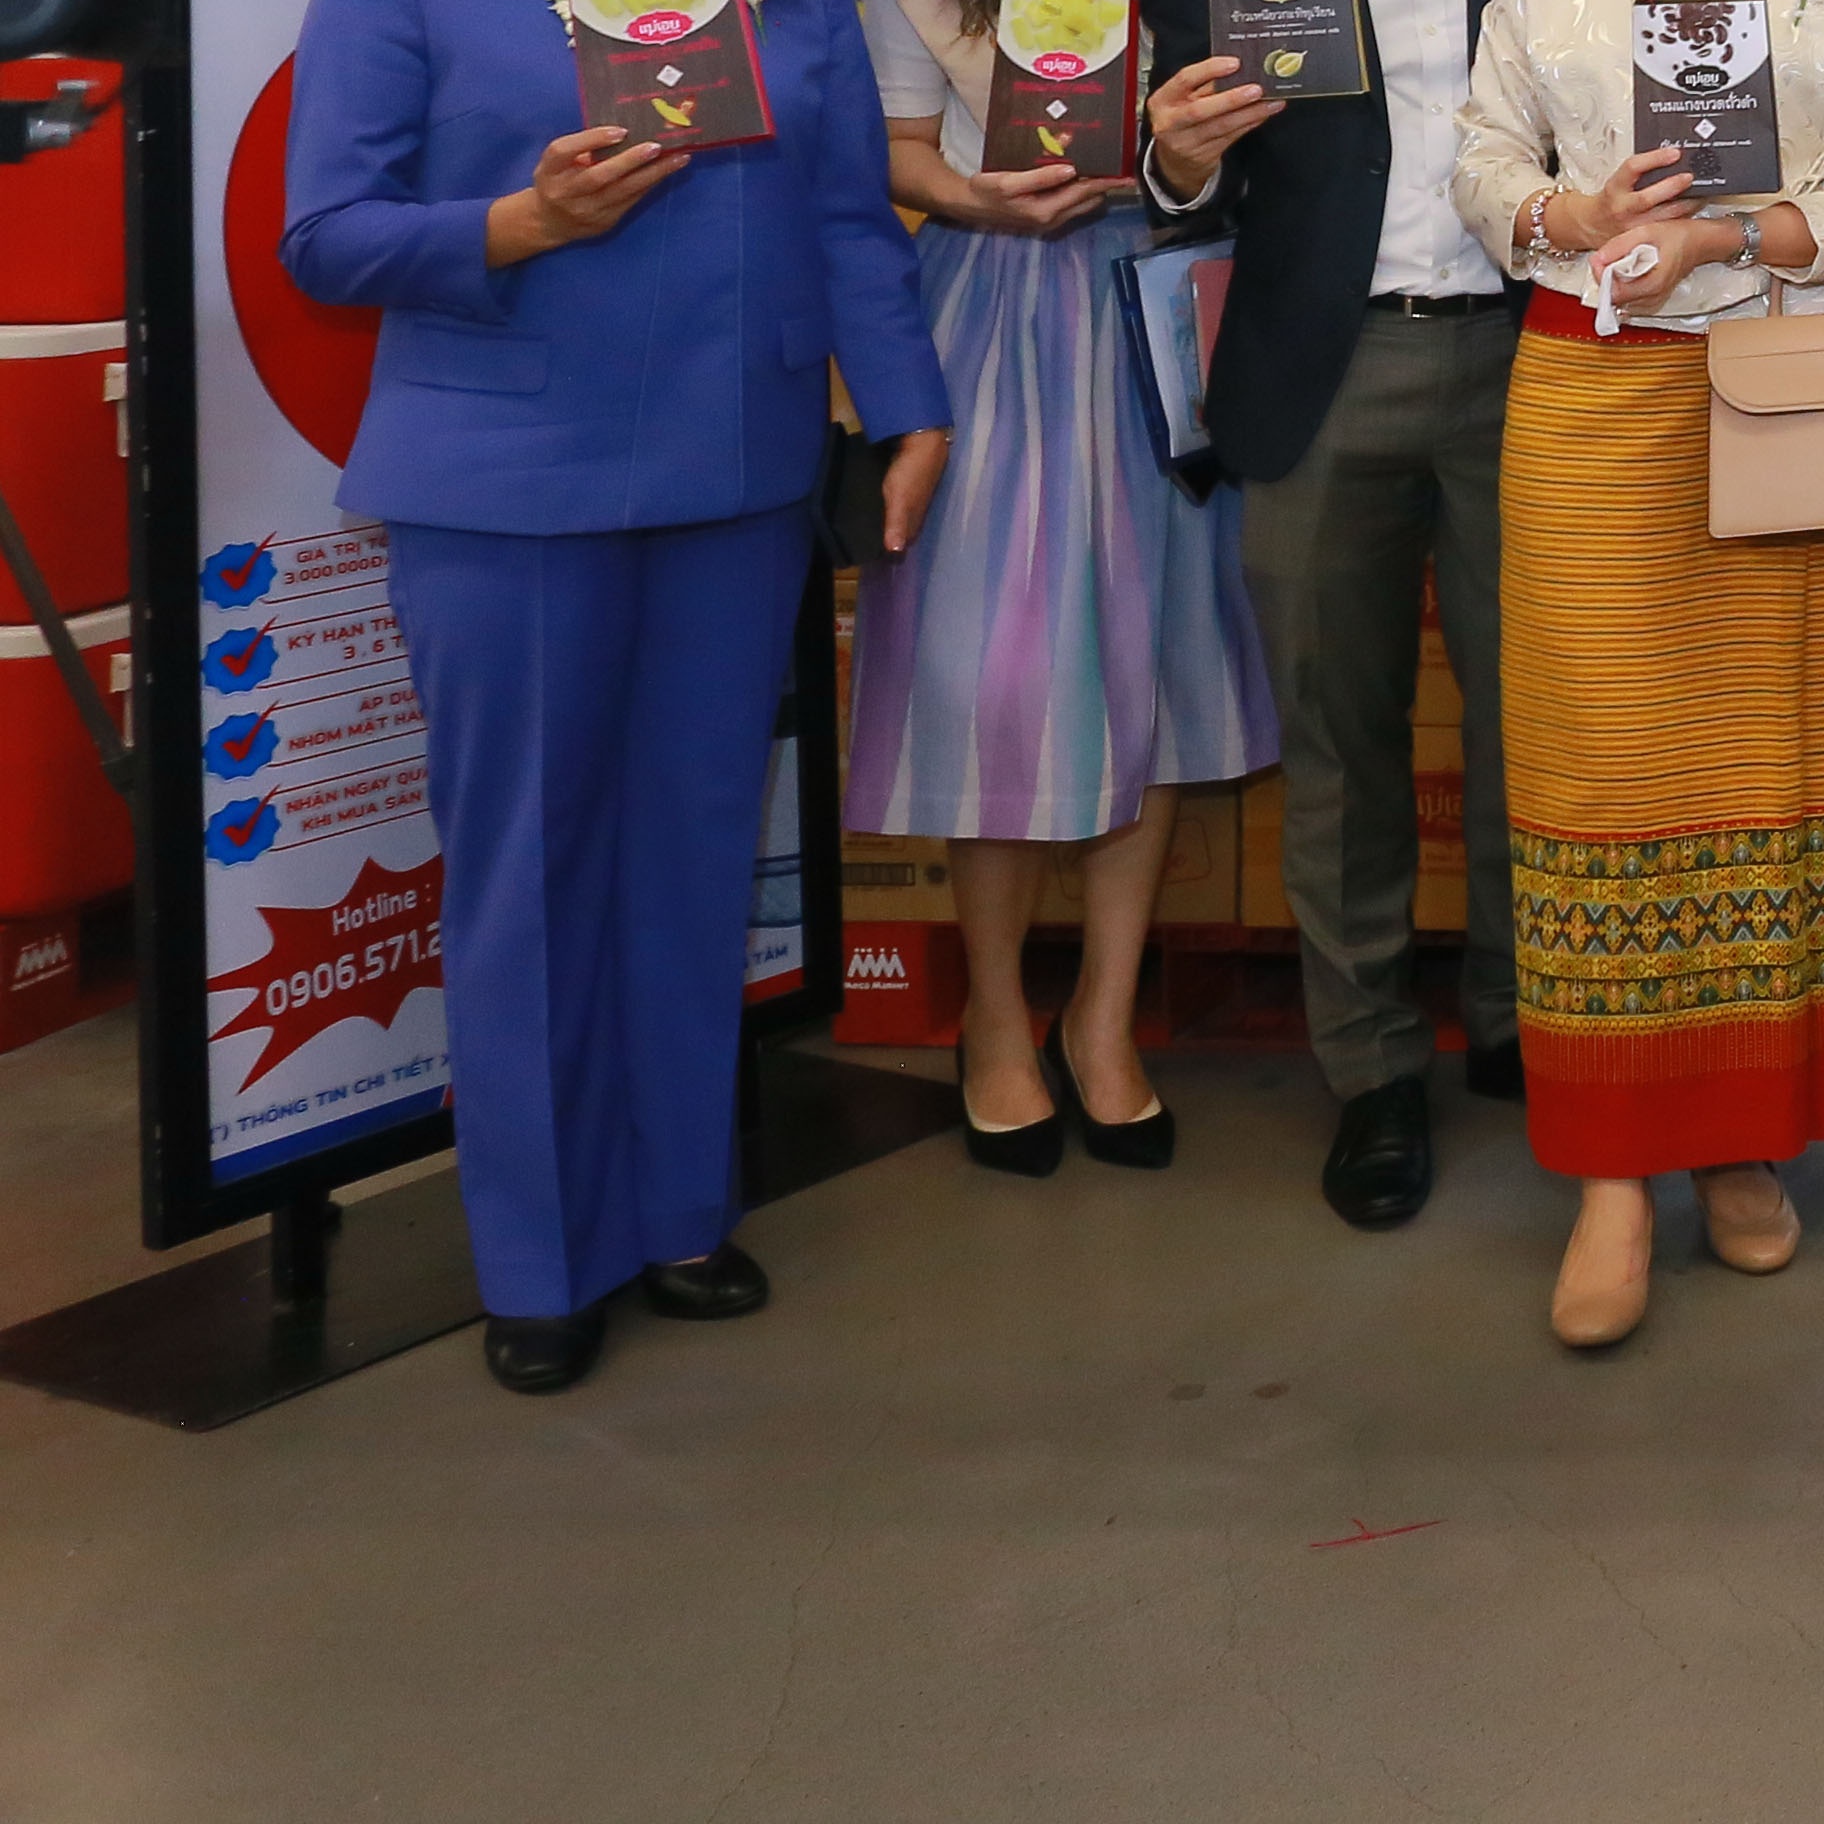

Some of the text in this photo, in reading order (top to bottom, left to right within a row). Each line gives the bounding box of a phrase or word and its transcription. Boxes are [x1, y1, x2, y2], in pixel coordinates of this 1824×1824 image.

[343, 776, 391, 799] NGAY
[301, 816, 332, 833] KHI
[336, 802, 379, 823] MUA
[331, 888, 418, 937] Hotline
[236, 1053, 434, 1132] THÔNG TIN CHI TIẾT
